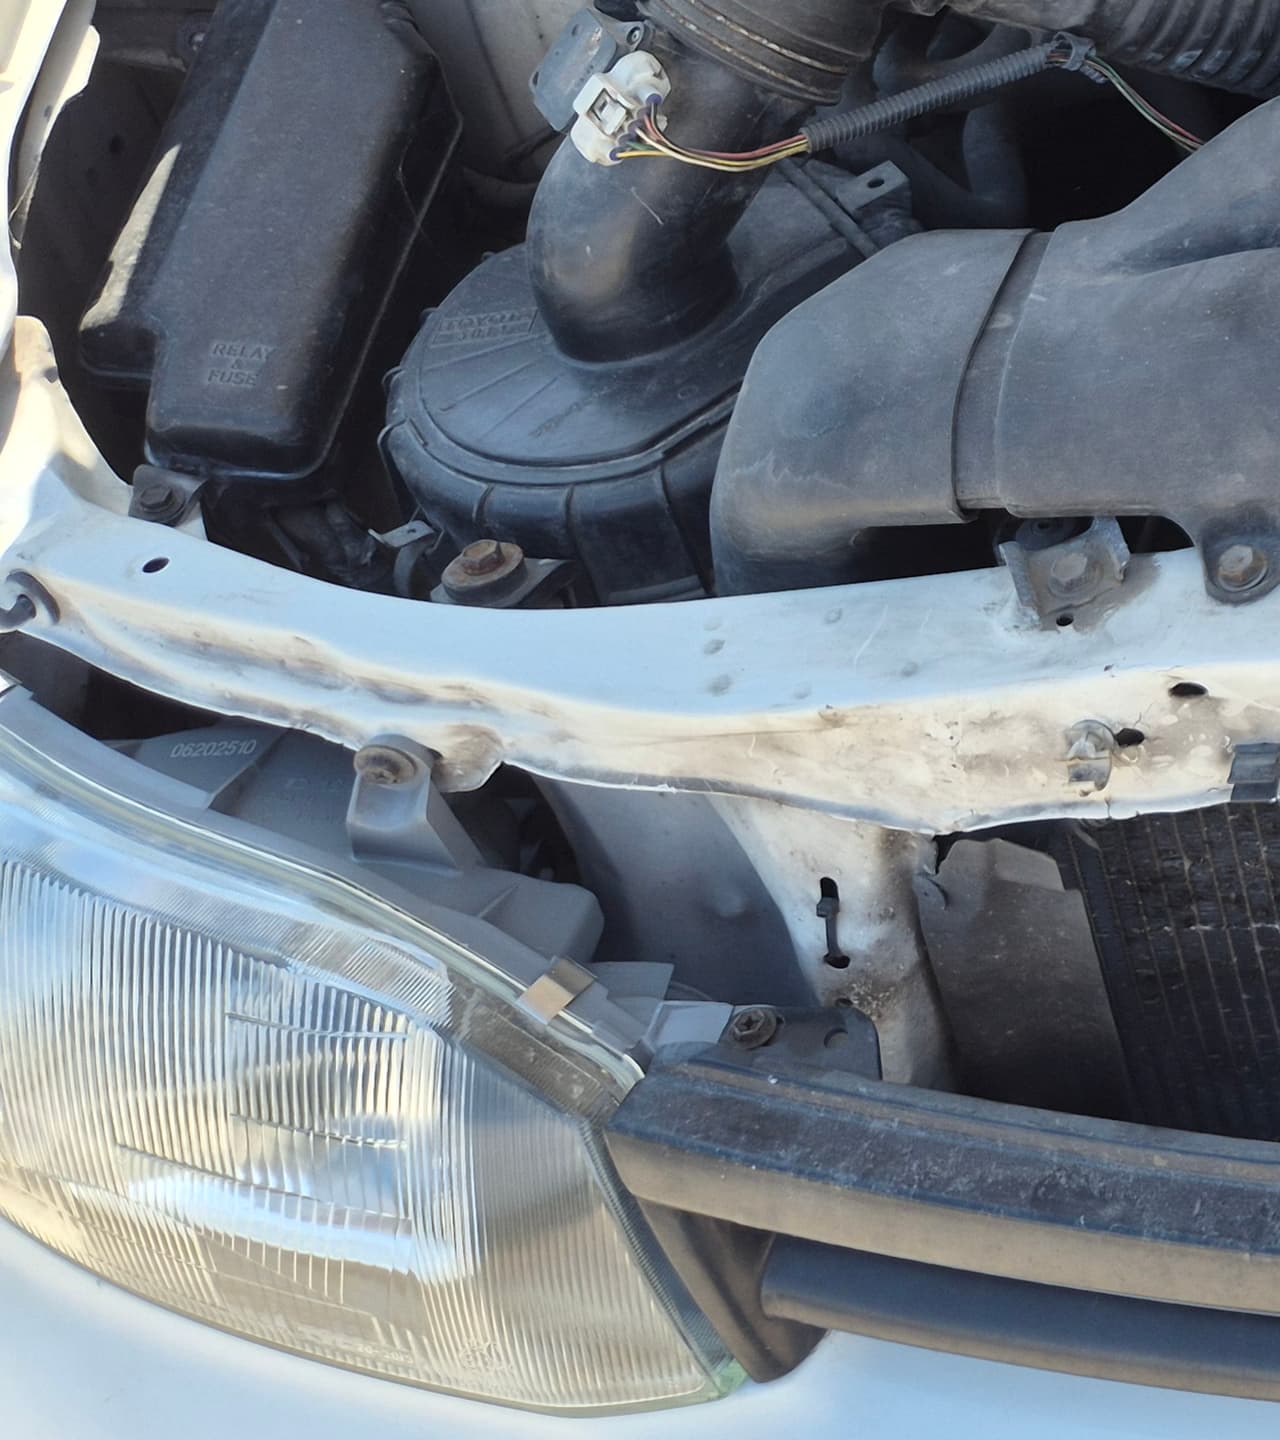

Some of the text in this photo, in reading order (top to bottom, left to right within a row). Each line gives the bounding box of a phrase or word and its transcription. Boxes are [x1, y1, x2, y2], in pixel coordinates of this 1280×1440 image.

[211, 342, 278, 359] RELAY
[207, 369, 257, 386] FUSE
[170, 739, 257, 758] 06202510
